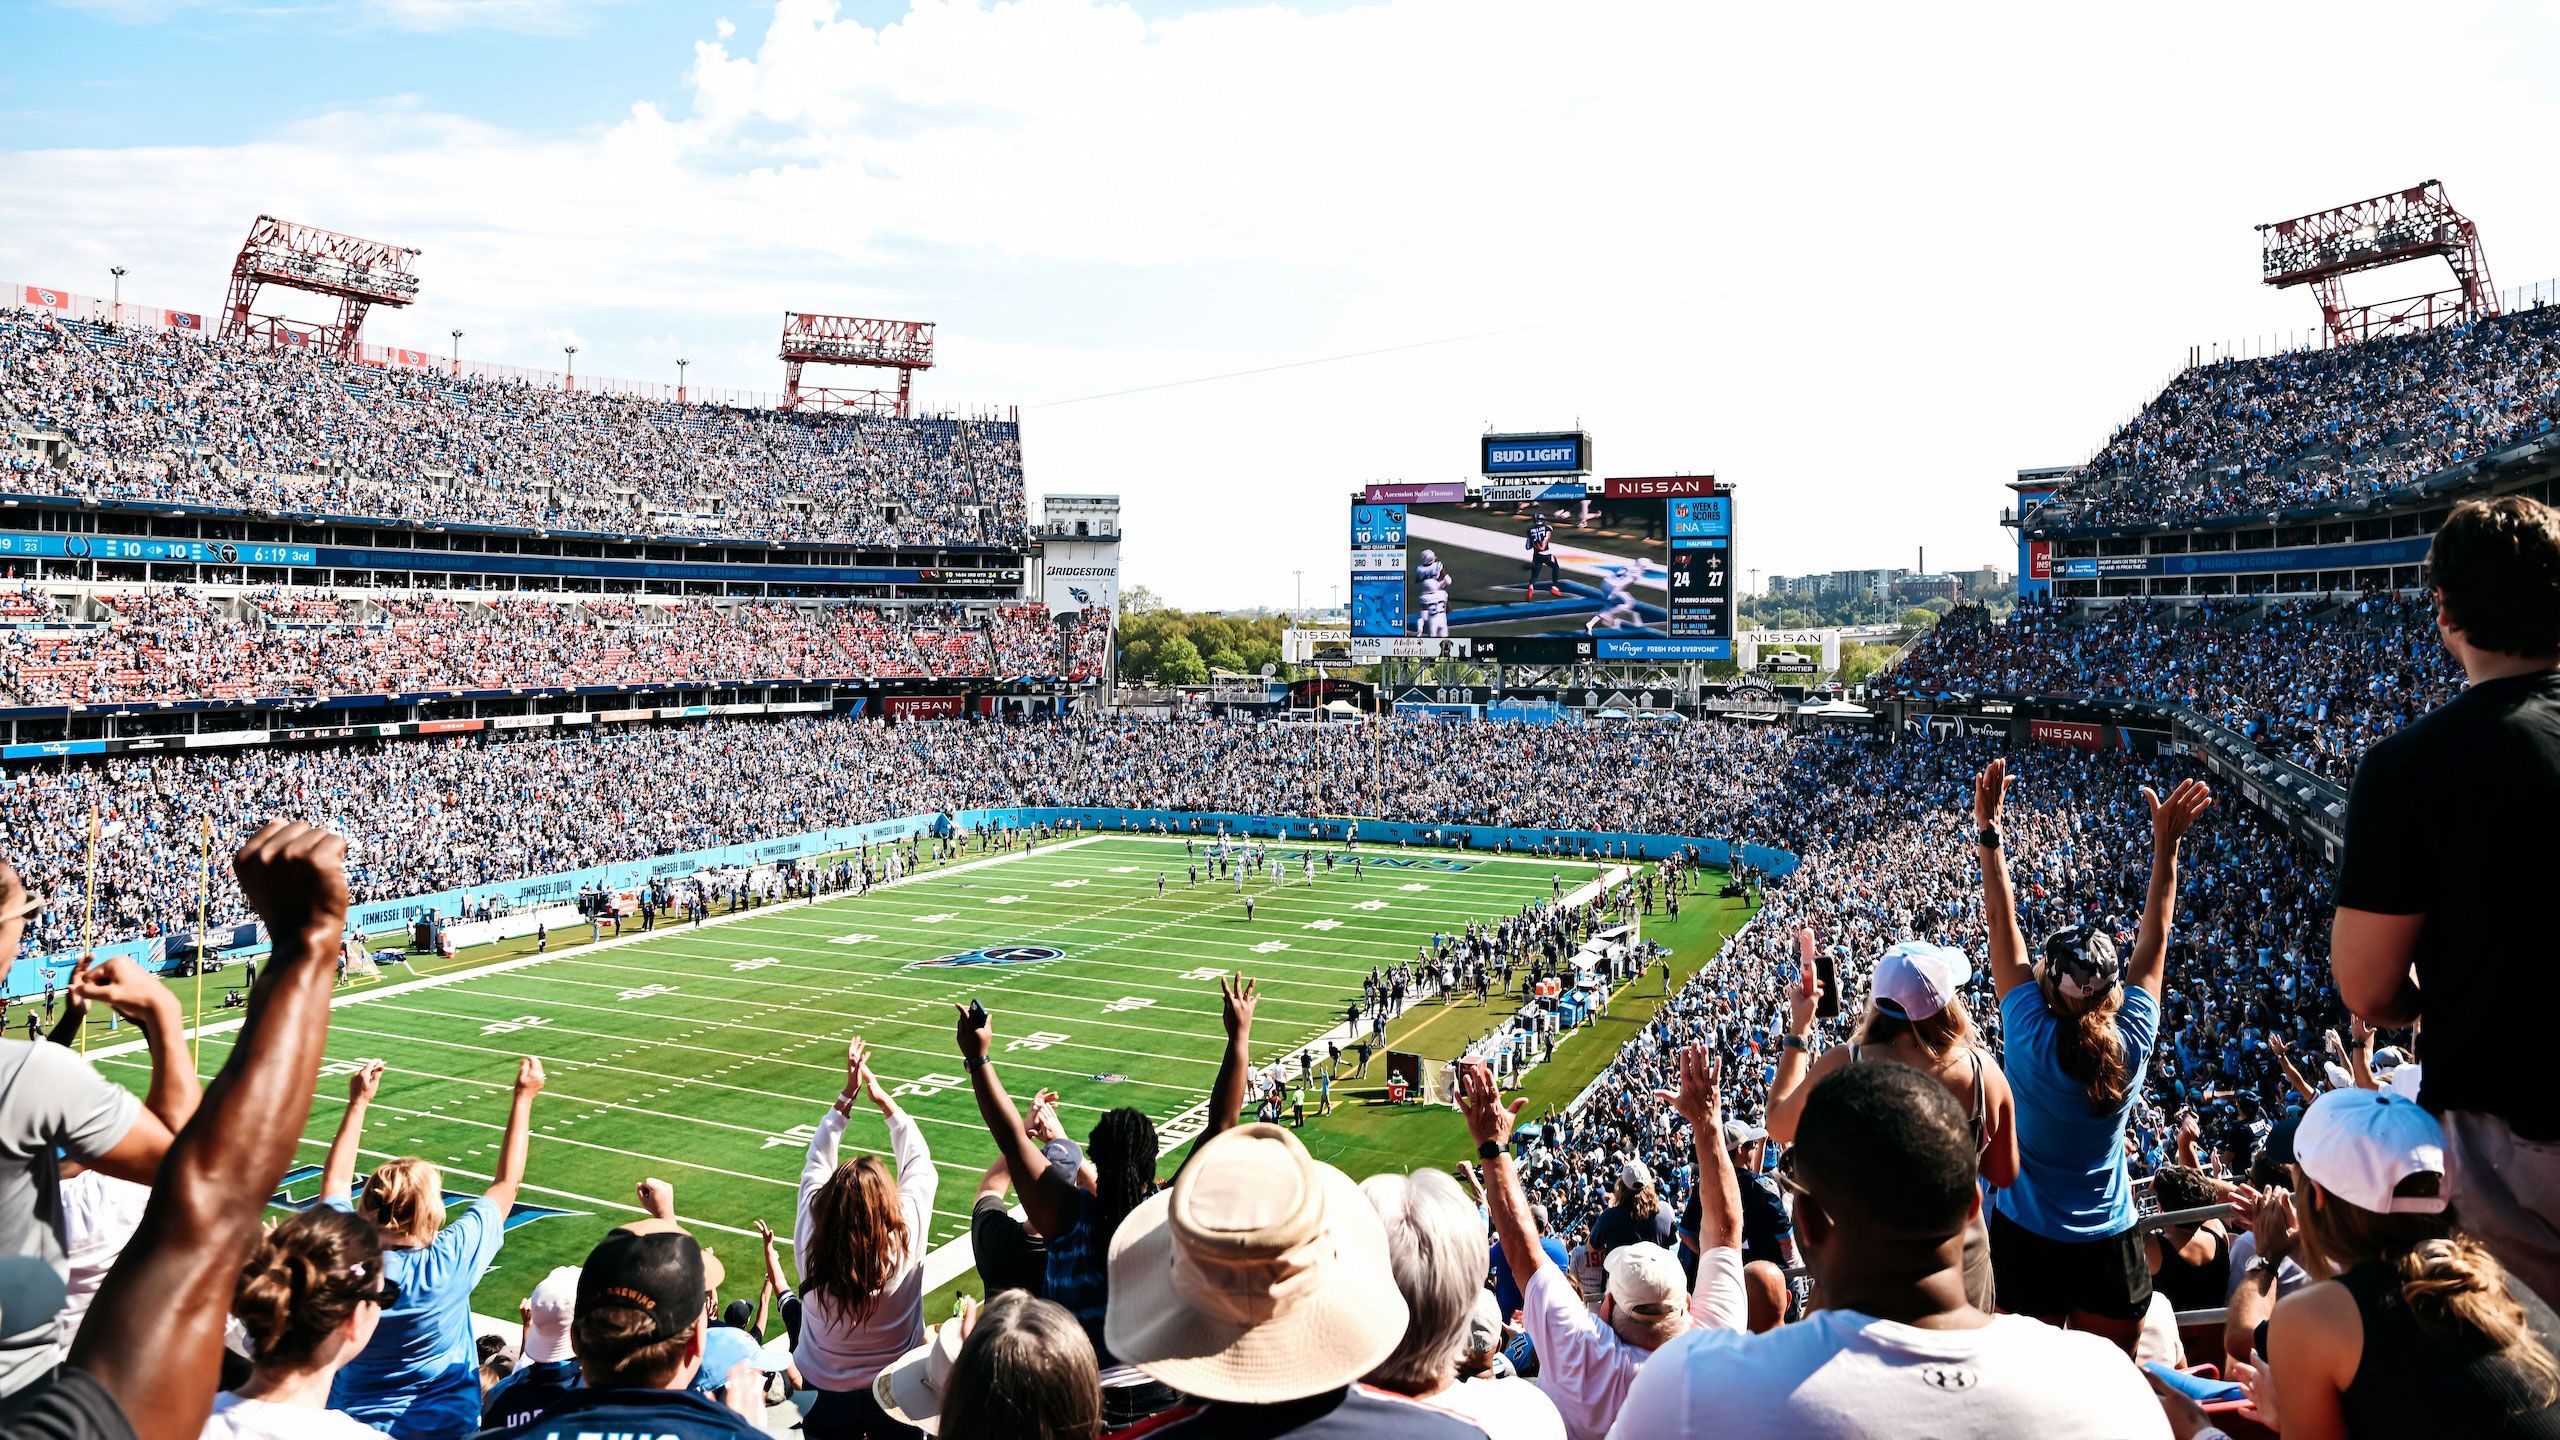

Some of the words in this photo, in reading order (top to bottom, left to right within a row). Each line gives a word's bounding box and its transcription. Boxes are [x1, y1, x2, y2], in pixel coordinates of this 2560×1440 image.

[1492, 449, 1525, 463] BUD
[1527, 448, 1572, 462] LIGHT
[1484, 487, 1531, 500] Pinnacle
[1618, 481, 1700, 494] NISSAN
[1692, 503, 1711, 511] WEEK
[1693, 512, 1720, 520] SCORES
[1357, 532, 1371, 543] 10
[1386, 531, 1400, 542] 10
[24, 543, 37, 552] 23
[123, 542, 141, 556] 10
[169, 544, 186, 558] 10
[254, 548, 286, 562] 6:19
[292, 550, 310, 562] 3rd
[1046, 566, 1116, 576] BRIDGESTONE
[1674, 572, 1690, 586] 24
[1708, 572, 1724, 586] 27
[1354, 639, 1380, 648] MARS
[1750, 634, 1821, 642] NISSAN
[1619, 642, 1643, 656] Kroger
[1727, 676, 1745, 693] JACK
[1746, 674, 1776, 692] DANIEL'S
[2039, 728, 2093, 740] NISSAN
[362, 911, 400, 926] TENNESSEE
[1005, 1031, 1071, 1052] 30
[891, 1072, 967, 1097] 20
[1394, 1086, 1402, 1097] G
